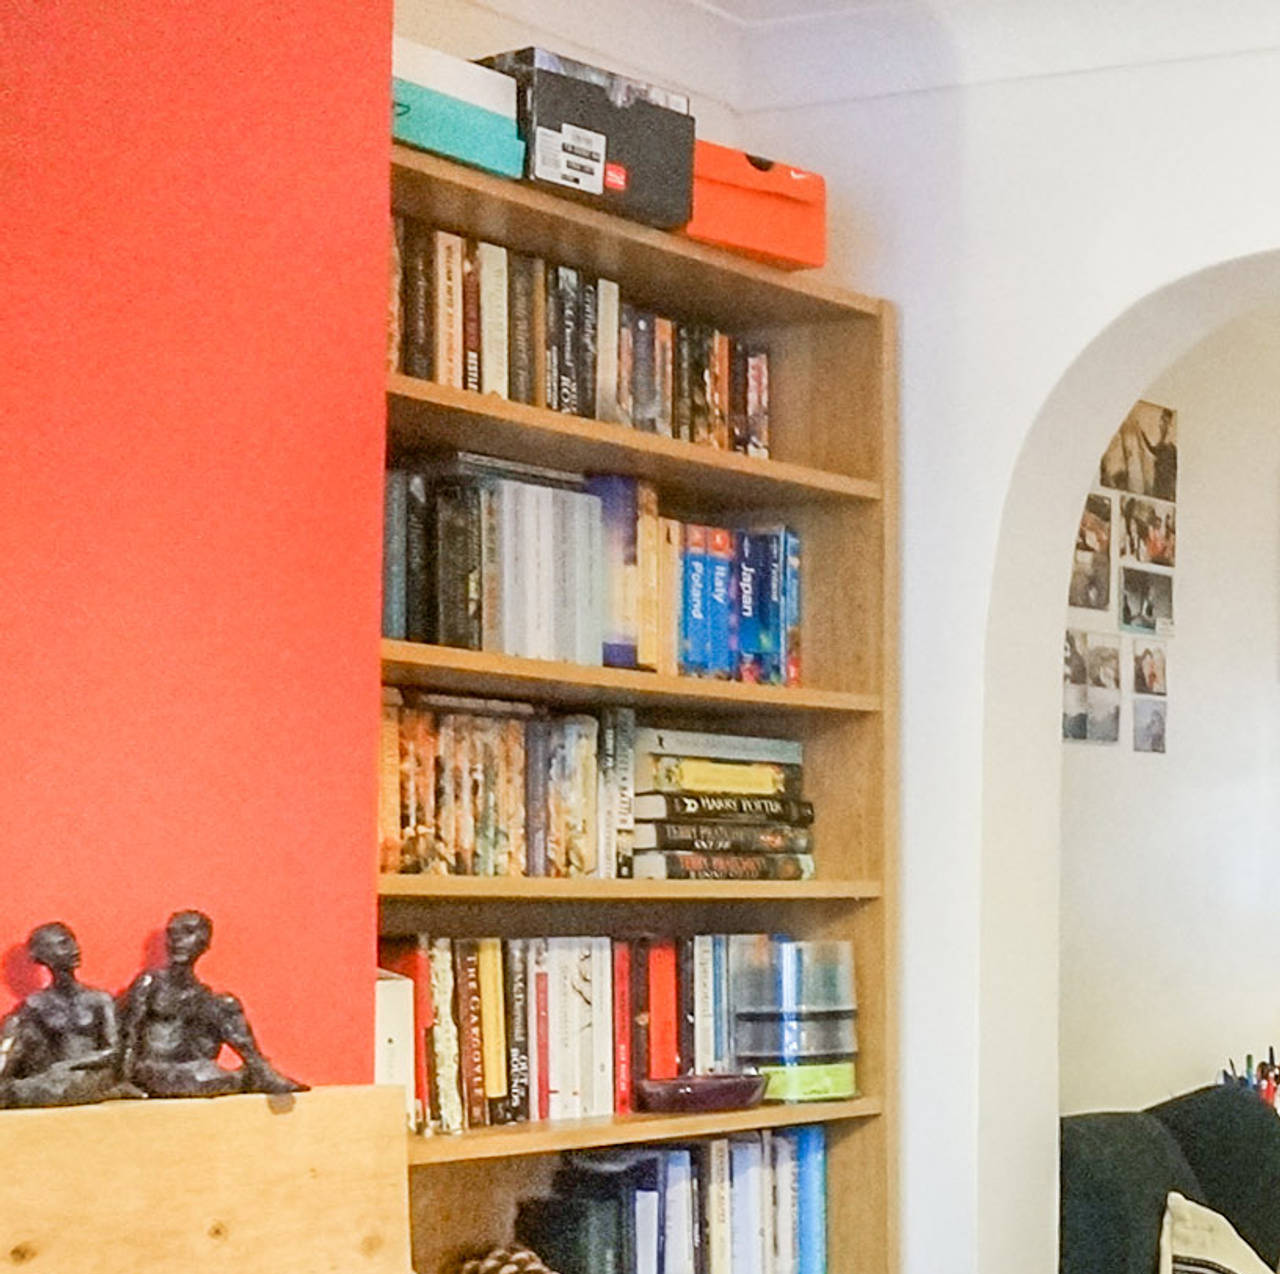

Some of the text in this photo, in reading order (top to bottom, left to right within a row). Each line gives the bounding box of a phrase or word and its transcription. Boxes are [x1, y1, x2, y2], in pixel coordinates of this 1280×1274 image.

[690, 560, 705, 619] Poland
[713, 564, 728, 605] Italy
[739, 561, 756, 618] Japan
[466, 953, 484, 1098] THE GARGOYLE
[519, 1055, 528, 1085] OUT
